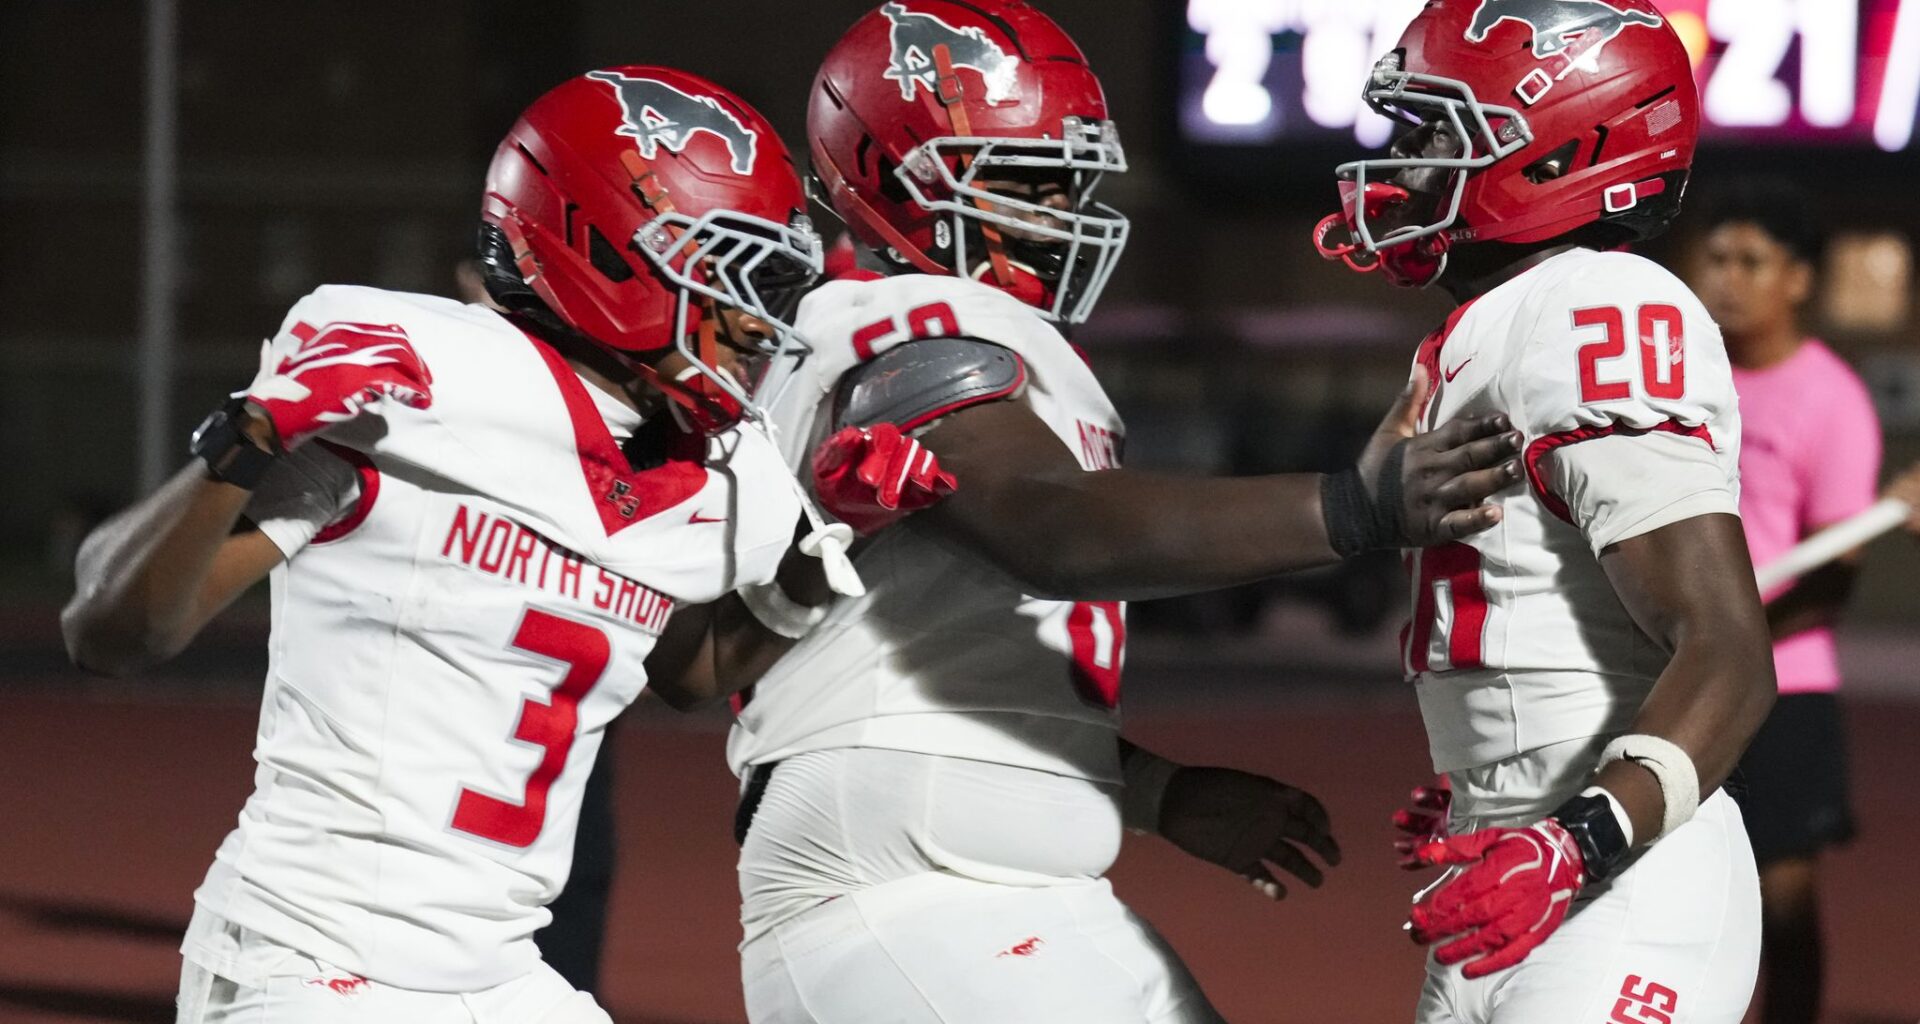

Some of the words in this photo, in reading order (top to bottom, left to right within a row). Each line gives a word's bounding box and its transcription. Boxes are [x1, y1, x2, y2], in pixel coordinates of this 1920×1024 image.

[1569, 301, 1687, 407] 20
[440, 503, 584, 600] NORTH
[443, 601, 613, 854] 3
[1606, 973, 1679, 1024] GS
